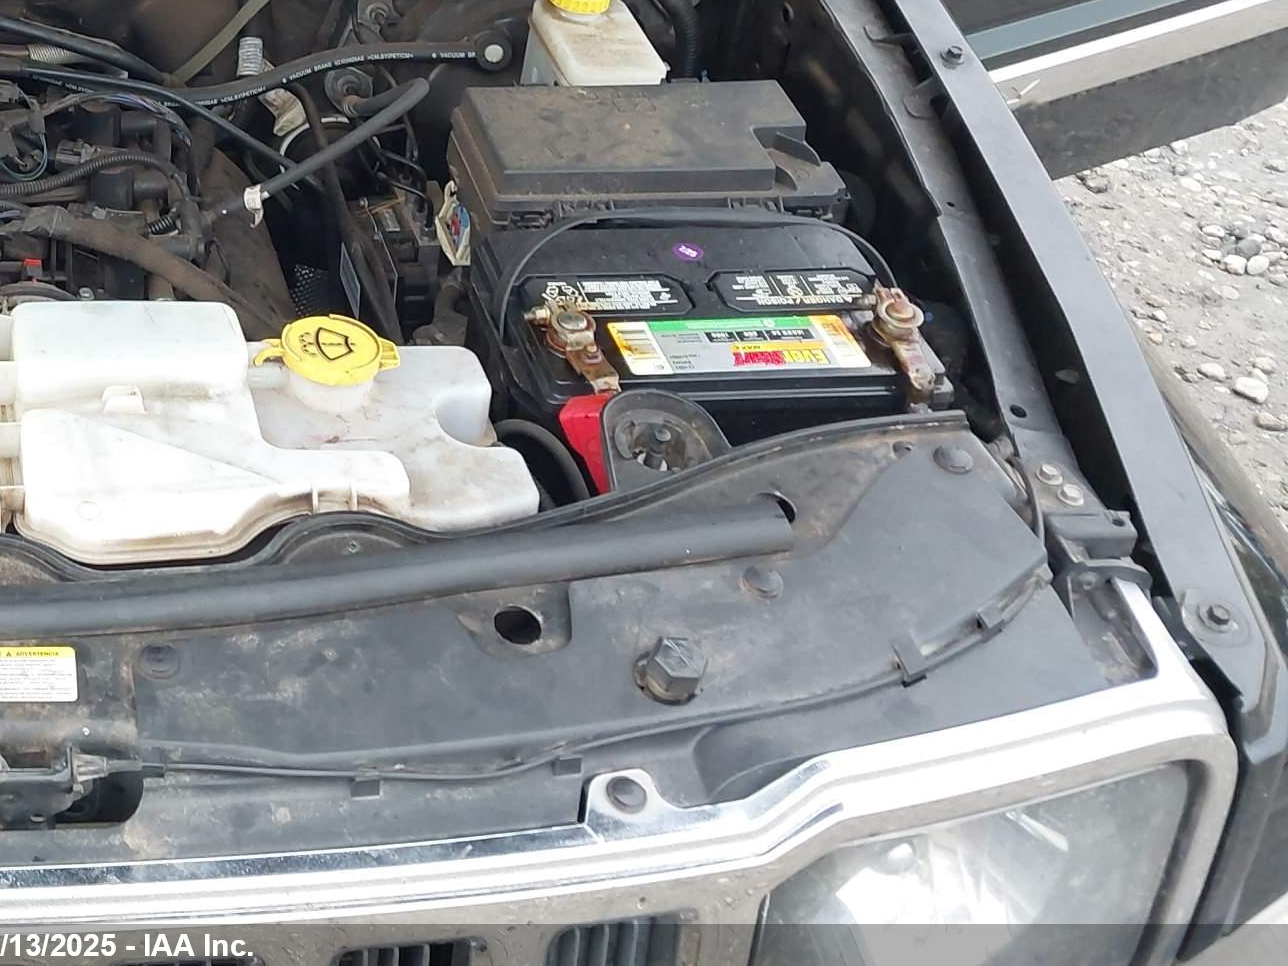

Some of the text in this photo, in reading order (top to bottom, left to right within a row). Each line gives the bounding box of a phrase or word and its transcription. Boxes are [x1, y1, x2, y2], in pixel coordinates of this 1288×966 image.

[289, 61, 332, 81] VACUUM BRAKE
[756, 296, 795, 305] POISON
